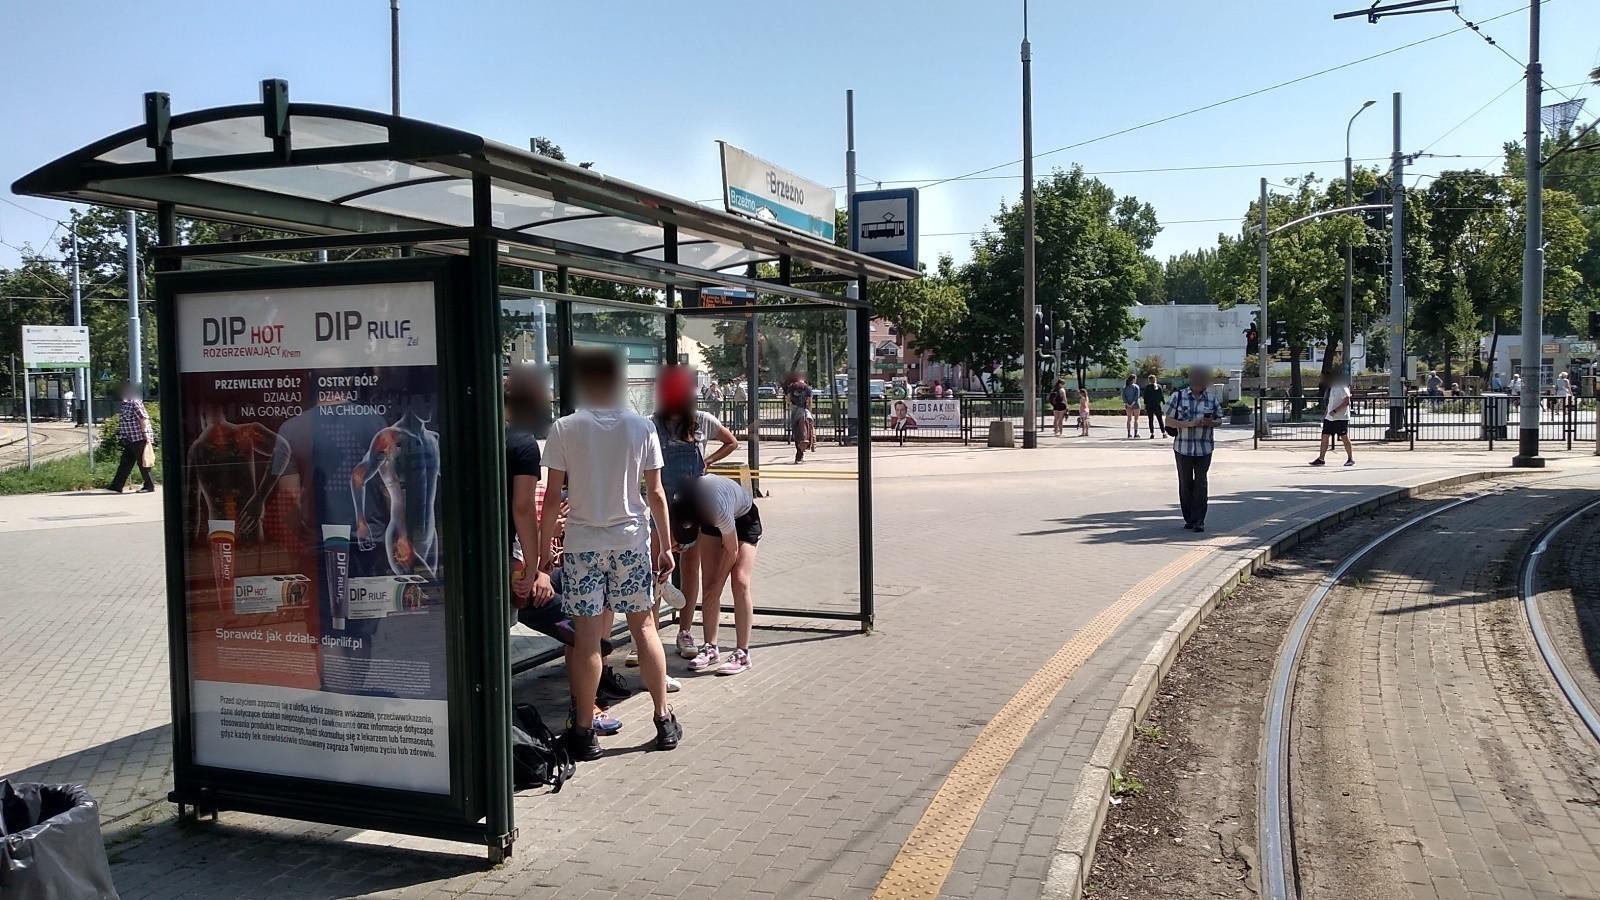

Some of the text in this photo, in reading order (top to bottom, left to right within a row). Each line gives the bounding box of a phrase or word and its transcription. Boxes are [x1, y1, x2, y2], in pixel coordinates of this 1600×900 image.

[203, 316, 284, 346] DIP HOT
[315, 310, 411, 341] DIP RILIF
[203, 346, 281, 358] ROZGRZEWAJĄCY
[214, 375, 301, 390] PRZEWLEKŁY BÓL?
[318, 373, 379, 388] OSTRY BÓL?
[263, 391, 302, 403] DZIAŁAJ
[318, 391, 358, 401] DZIAŁAJ
[241, 406, 303, 419] NA GORĄCO
[319, 405, 386, 416] NA CHŁODNO
[222, 543, 232, 563] DIP
[337, 552, 346, 576] DIP
[236, 585, 254, 598] DIP
[350, 588, 367, 602] DIP
[215, 627, 263, 641] Sprawdź
[266, 630, 282, 643] jak
[321, 634, 363, 650] diprilif.pl
